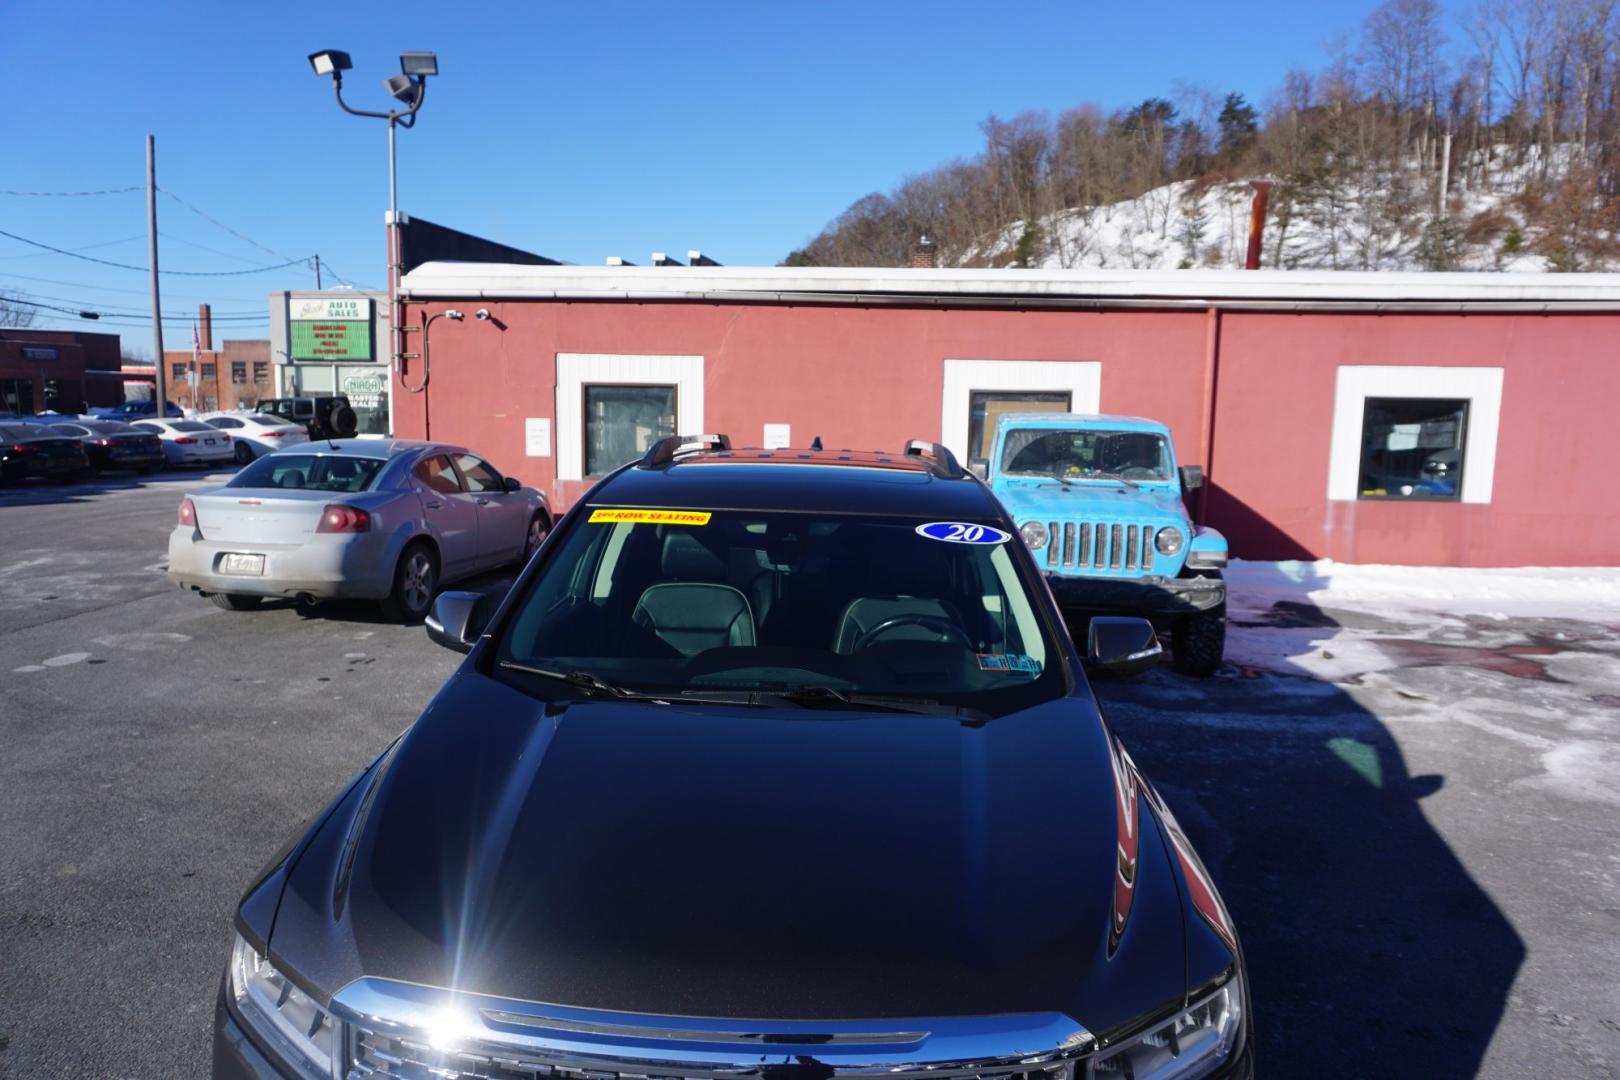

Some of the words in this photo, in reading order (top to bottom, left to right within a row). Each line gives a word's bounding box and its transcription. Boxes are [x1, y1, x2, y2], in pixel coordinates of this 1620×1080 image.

[329, 301, 357, 309] AUTO
[328, 309, 359, 317] SALES
[614, 511, 647, 520] ROW
[647, 513, 708, 522] SEATING
[943, 524, 984, 542] 20
